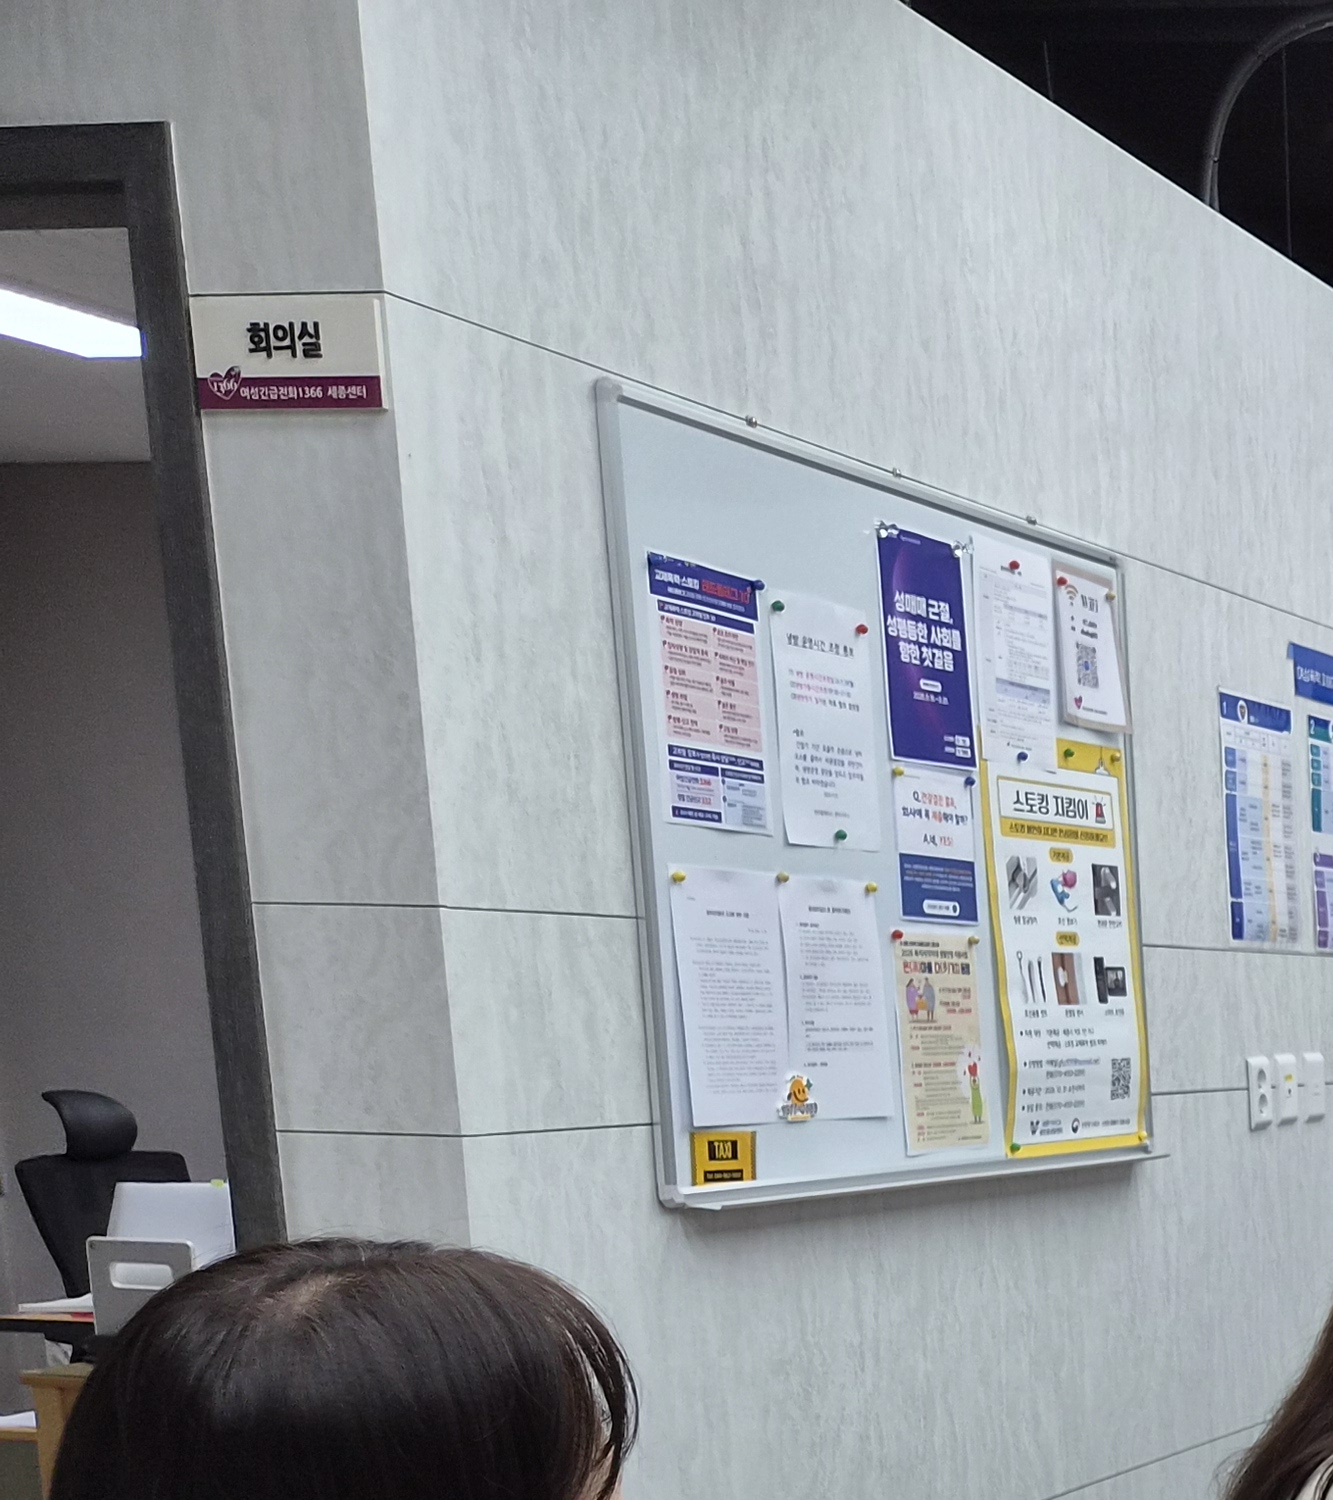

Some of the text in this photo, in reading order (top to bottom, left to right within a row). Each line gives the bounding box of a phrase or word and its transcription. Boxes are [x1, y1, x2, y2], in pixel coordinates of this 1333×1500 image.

[246, 321, 323, 358] 회의실
[240, 384, 367, 400] 여성긴급전화1366 세종센터
[894, 590, 927, 618] 성매매
[887, 614, 962, 651] 성평등한 사회를
[898, 641, 954, 672] 향한 첫걸음
[1013, 790, 1090, 820] 스토킹 지킴이
[714, 1141, 732, 1159] TAXI
